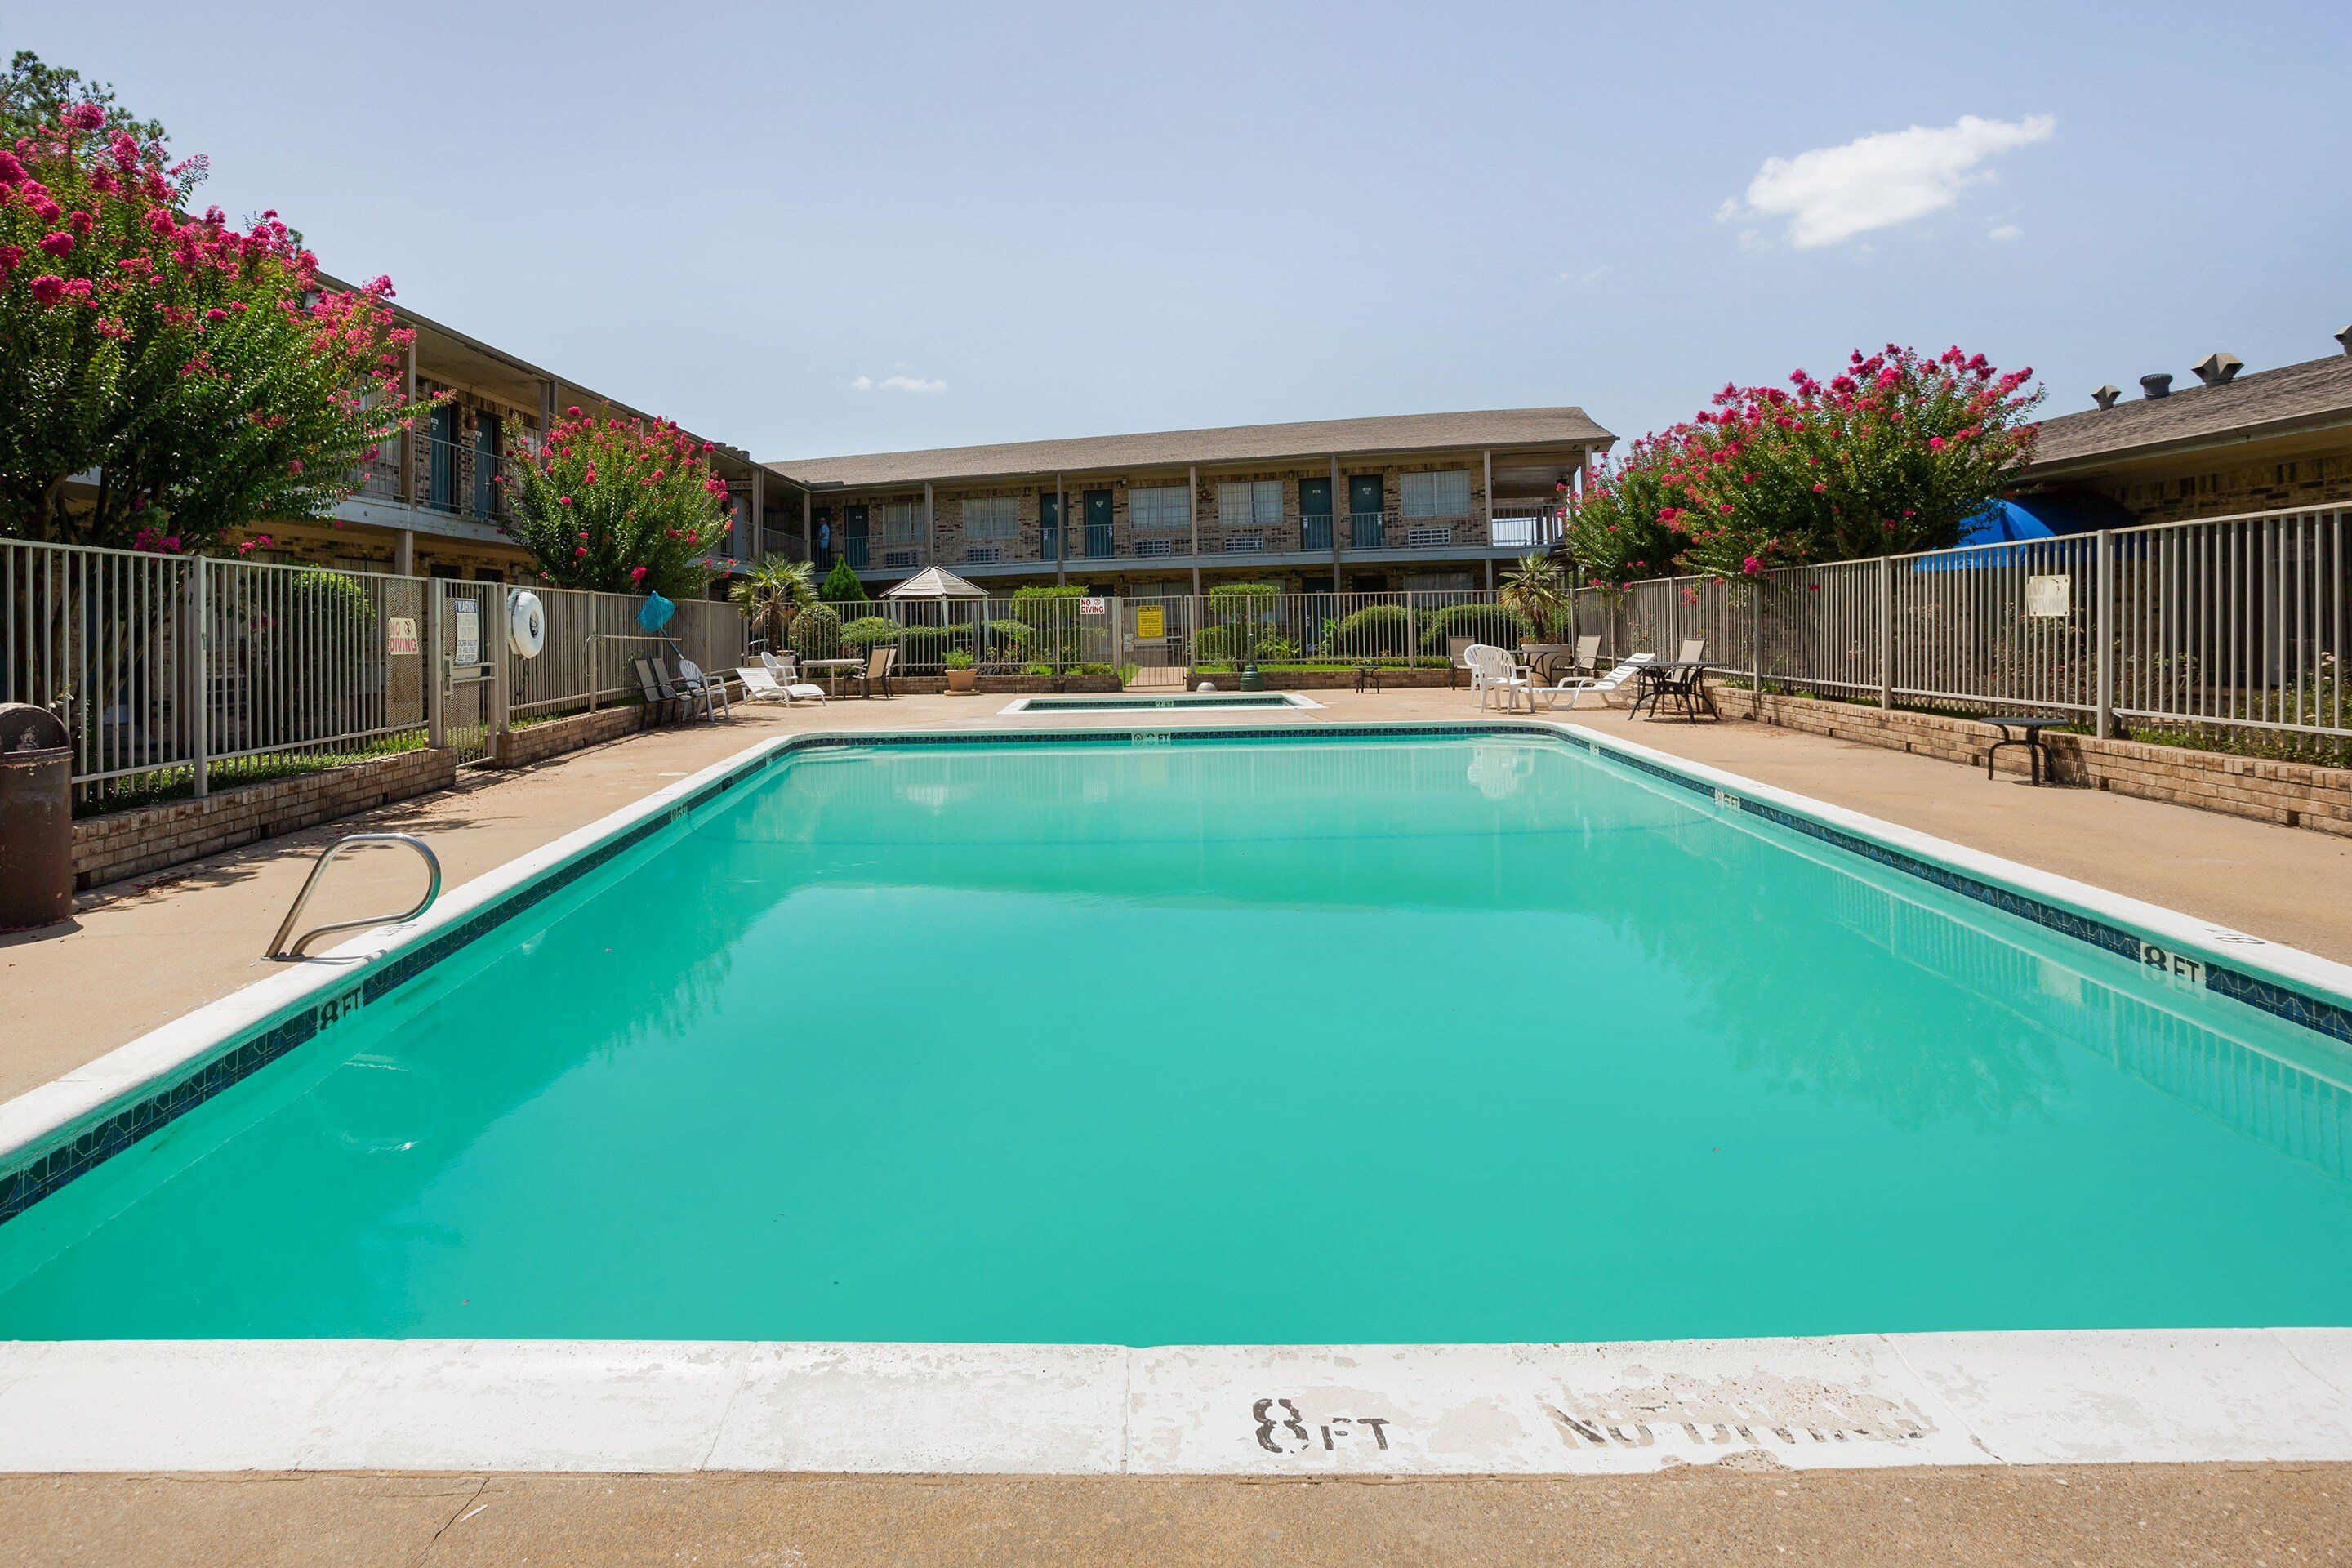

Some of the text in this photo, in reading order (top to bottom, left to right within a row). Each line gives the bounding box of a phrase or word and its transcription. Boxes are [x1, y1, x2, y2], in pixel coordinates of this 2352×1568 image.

[390, 621, 400, 635] NO
[390, 637, 417, 652] DIVING
[2144, 945, 2200, 982] 8 FT
[320, 987, 361, 1031] 8 FT
[1253, 1398, 1390, 1454] 8 FT
